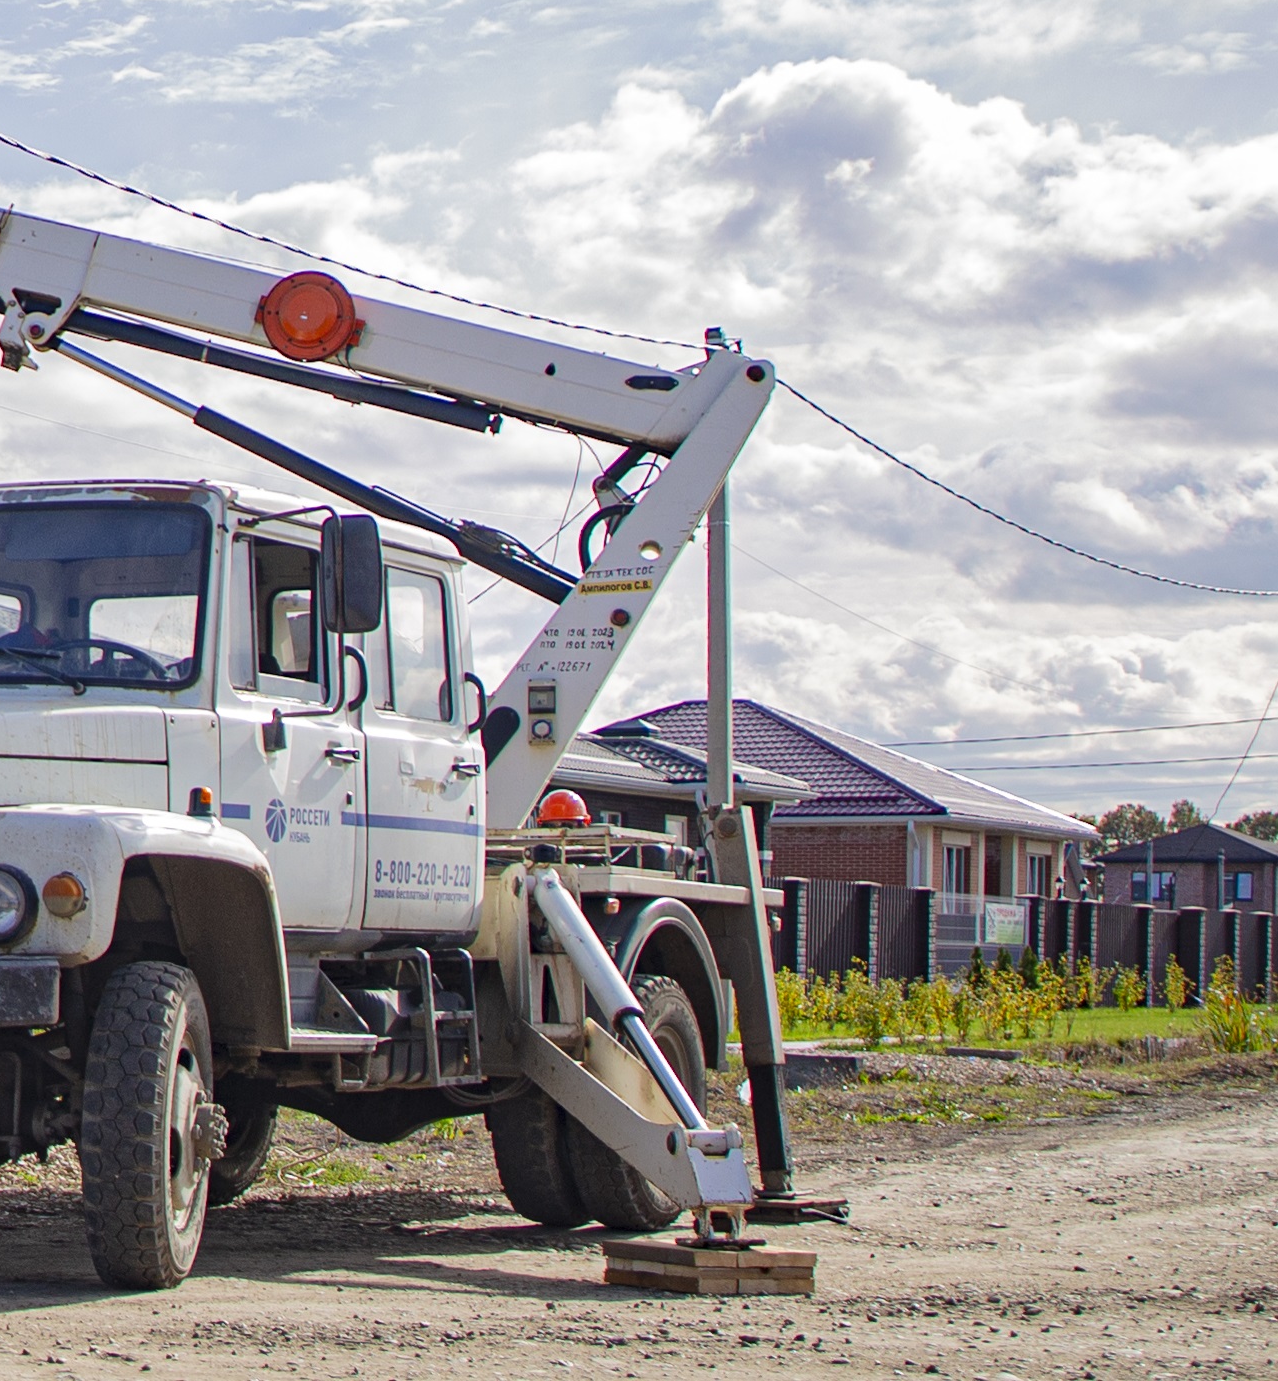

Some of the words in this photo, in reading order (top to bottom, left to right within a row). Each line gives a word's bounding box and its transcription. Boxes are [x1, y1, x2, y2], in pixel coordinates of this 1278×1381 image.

[580, 582, 632, 593] Ампилогов
[634, 580, 651, 589] С.В.
[592, 627, 614, 637] 2023
[590, 640, 615, 651] 2024
[289, 807, 330, 826] РОССЕТИ
[289, 831, 310, 843] КУБАНЬ
[375, 859, 471, 887] 8-800-220-0-220
[373, 888, 394, 899] звонок
[396, 887, 429, 900] бесплатный
